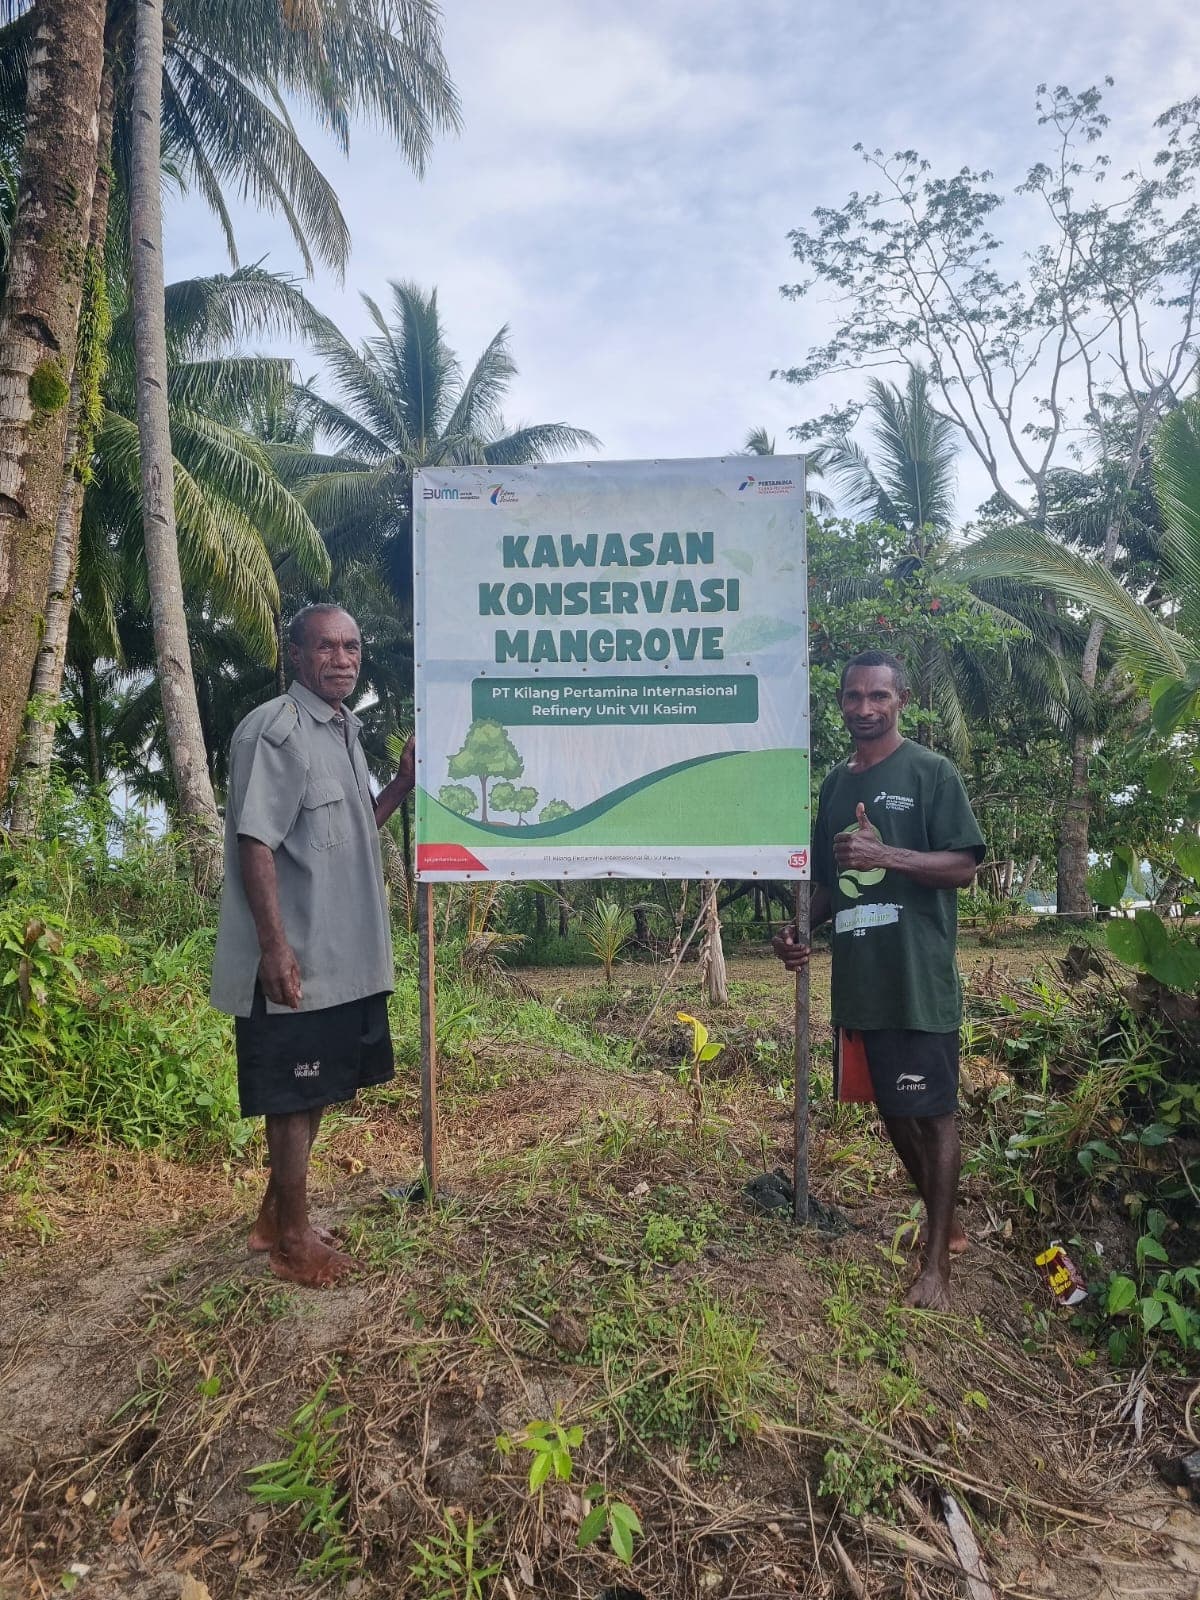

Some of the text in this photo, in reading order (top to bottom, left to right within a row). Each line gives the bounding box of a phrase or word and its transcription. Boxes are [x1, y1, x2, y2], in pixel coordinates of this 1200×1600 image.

[423, 488, 459, 500] BUMN
[502, 531, 715, 569] KAWASAN
[478, 578, 740, 616] KONSERVASI
[494, 627, 724, 664] MANGROVE
[492, 684, 738, 701] PT Kilang Pertamina Internasional
[532, 703, 697, 719] Refinery Unit VII Kasim
